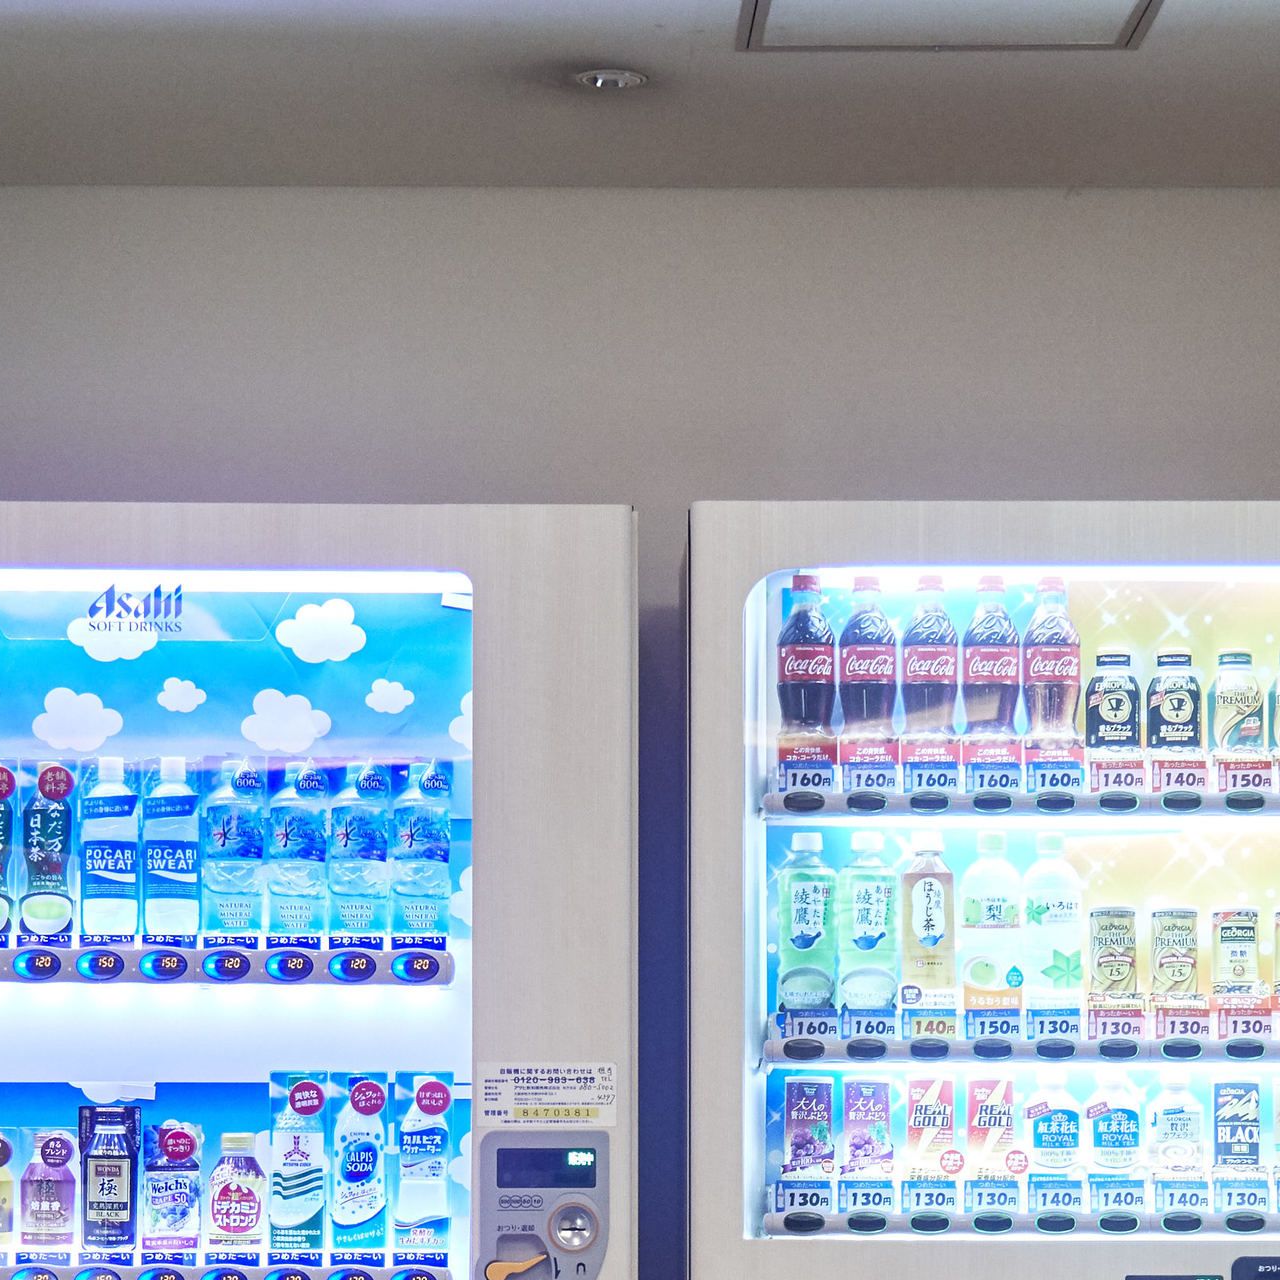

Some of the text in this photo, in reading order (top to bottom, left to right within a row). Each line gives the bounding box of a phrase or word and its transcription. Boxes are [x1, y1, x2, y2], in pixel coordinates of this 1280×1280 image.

[88, 583, 182, 619] Asahi
[88, 621, 182, 633] SOFT DRINKS
[785, 655, 833, 676] Coca-Cola
[846, 655, 894, 676] Coca-Cola
[907, 655, 955, 676] Coca-Cola
[969, 655, 1017, 676] Coca-Cola
[1030, 655, 1078, 676] Coca-Cola
[1217, 695, 1261, 705] PREMIUM
[790, 772, 831, 788] 160円
[855, 774, 896, 788] 160円
[916, 773, 957, 787] 160円
[978, 774, 1019, 788] 160円
[1040, 773, 1080, 788] 160円
[1103, 773, 1144, 787] 140円
[1165, 773, 1206, 787] 140円
[1232, 774, 1272, 788] 150円
[28, 813, 46, 862] 日本茶
[86, 848, 136, 860] POCARI
[147, 848, 197, 860] POCARI
[86, 860, 133, 870] SWEAT
[147, 860, 194, 870] SWEAT
[793, 887, 810, 926] 綾鷹
[856, 887, 872, 926] 綾鷹
[922, 880, 936, 932] ほうじ茶
[986, 904, 1002, 921] 梨
[1222, 926, 1255, 938] GEORGIA
[1094, 936, 1136, 947] PREMIUM
[1156, 936, 1198, 947] PREMIUM
[36, 956, 52, 966] 120
[98, 957, 114, 967] 150
[161, 958, 177, 968] 150
[224, 958, 240, 968] 120
[288, 958, 304, 968] 120
[350, 958, 366, 968] 120
[414, 959, 430, 969] 120
[797, 1020, 837, 1035] 160円
[855, 1020, 895, 1035] 160円
[916, 1020, 956, 1034] 140円
[979, 1020, 1020, 1034] 150円
[1038, 1020, 1078, 1034] 130円
[1101, 1021, 1140, 1035] 130円
[1170, 1020, 1209, 1034] 130円
[1232, 1020, 1272, 1034] 130円
[793, 1098, 825, 1112] 大人の
[850, 1098, 882, 1112] 大人の
[914, 1104, 948, 1116] REAL
[978, 1104, 1012, 1116] REAL
[914, 1116, 950, 1127] GOLD
[978, 1116, 1012, 1127] GOLD
[1038, 1121, 1079, 1134] 紅茶花伝
[1098, 1120, 1138, 1134] 紅茶花伝
[402, 1136, 442, 1144] カルピス
[1042, 1134, 1074, 1142] ROYAL
[1218, 1126, 1260, 1143] BLACK
[44, 1148, 68, 1156] ブレンド
[402, 1144, 442, 1153] ウォーター
[346, 1152, 373, 1162] CALPIS
[346, 1162, 373, 1172] SODA
[98, 1178, 118, 1196] 極
[150, 1180, 188, 1194] Welch's
[174, 1194, 186, 1204] 50
[789, 1192, 829, 1206] 130円
[852, 1192, 892, 1206] 130円
[914, 1192, 955, 1206] 130円
[977, 1192, 1017, 1206] 130円
[1041, 1192, 1082, 1206] 140円
[1104, 1192, 1144, 1206] 140円
[1169, 1192, 1208, 1206] 140円
[1227, 1192, 1267, 1206] 130円
[214, 1202, 258, 1214] ドデカミン
[216, 1214, 256, 1226] ストロング
